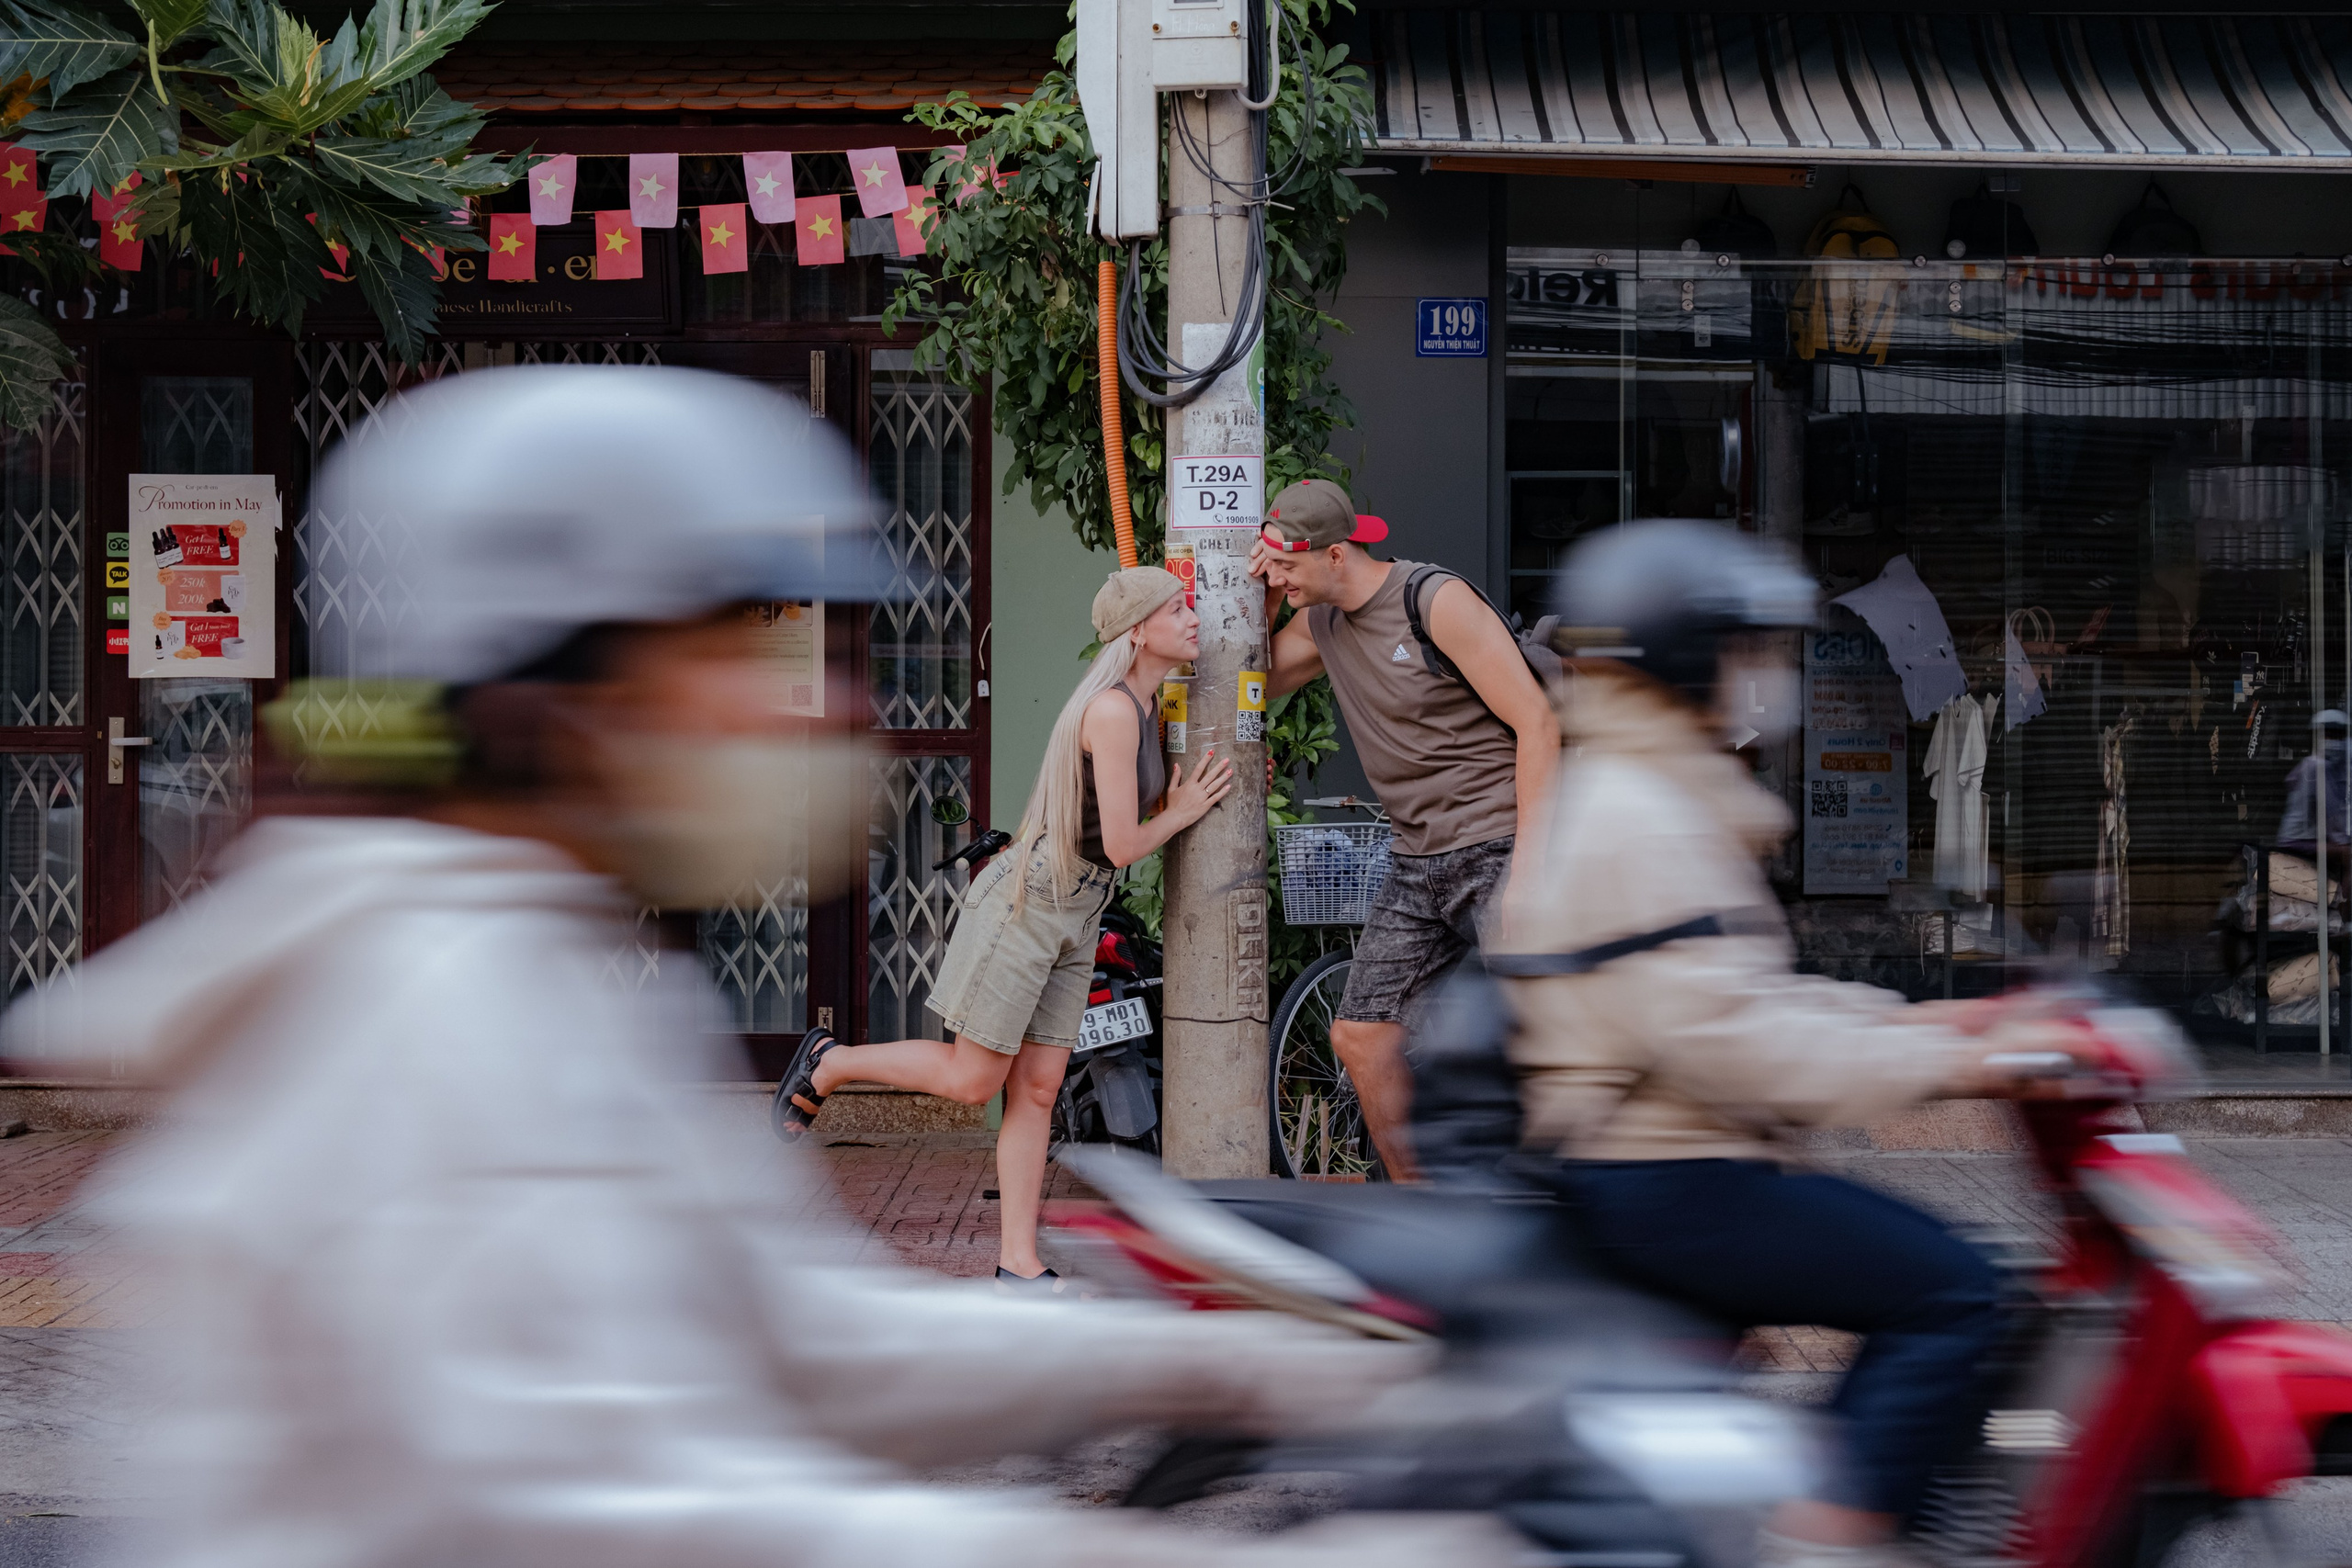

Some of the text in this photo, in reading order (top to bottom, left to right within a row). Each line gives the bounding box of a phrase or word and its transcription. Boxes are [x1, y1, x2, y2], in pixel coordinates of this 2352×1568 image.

[479, 299, 572, 313] Handicrafts
[1430, 305, 1476, 336] 199
[1423, 335, 1481, 351] NGUYỄN THIỆN THUẬT
[1186, 465, 1248, 483] T.29A
[139, 484, 263, 514] Promotion in May
[1199, 491, 1238, 511] D-2
[1226, 514, 1260, 525] 19001909
[186, 545, 214, 557] FREE
[179, 577, 206, 588] 250k
[177, 593, 205, 604] 200k
[112, 602, 126, 615] N
[189, 622, 204, 632] Get
[191, 632, 219, 644] FREE
[1392, 652, 1411, 662] adidas
[1167, 741, 1184, 751] SBER
[1077, 1018, 1147, 1048] 096.30
